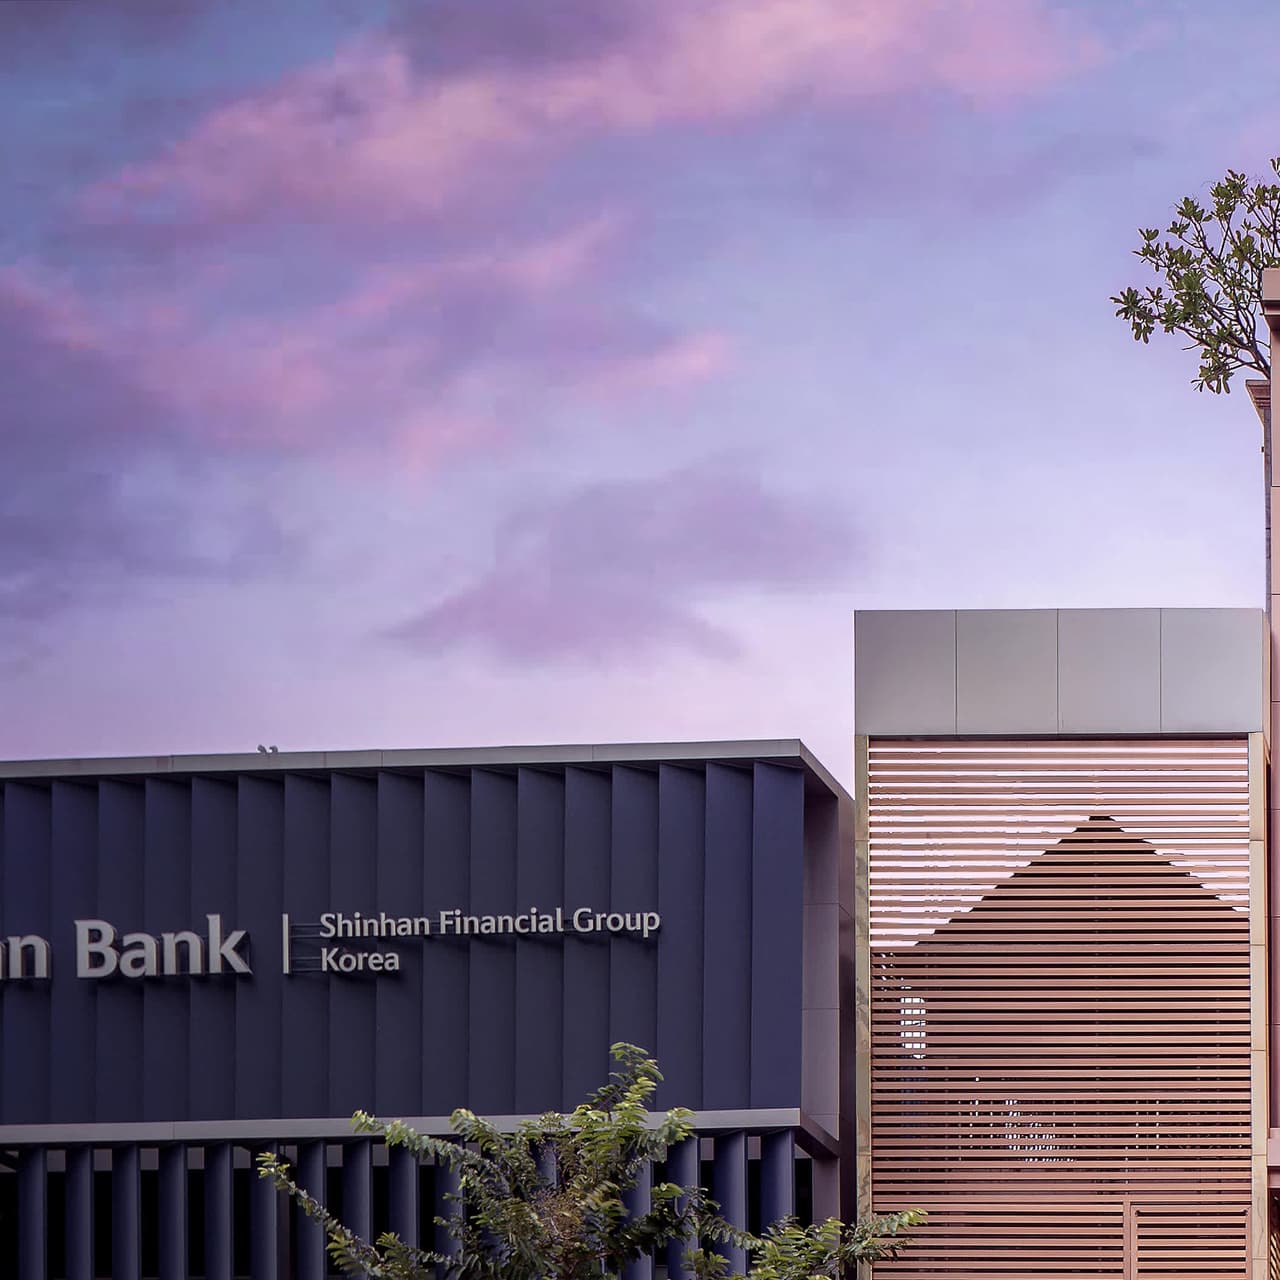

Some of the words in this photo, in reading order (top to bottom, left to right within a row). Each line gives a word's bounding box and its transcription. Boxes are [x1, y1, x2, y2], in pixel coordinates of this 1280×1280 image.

[319, 911, 430, 939] Shinhan
[438, 908, 565, 935] Financial
[572, 906, 661, 938] Group
[0, 934, 48, 979] n
[74, 914, 253, 979] Bank
[320, 947, 400, 973] Korea
